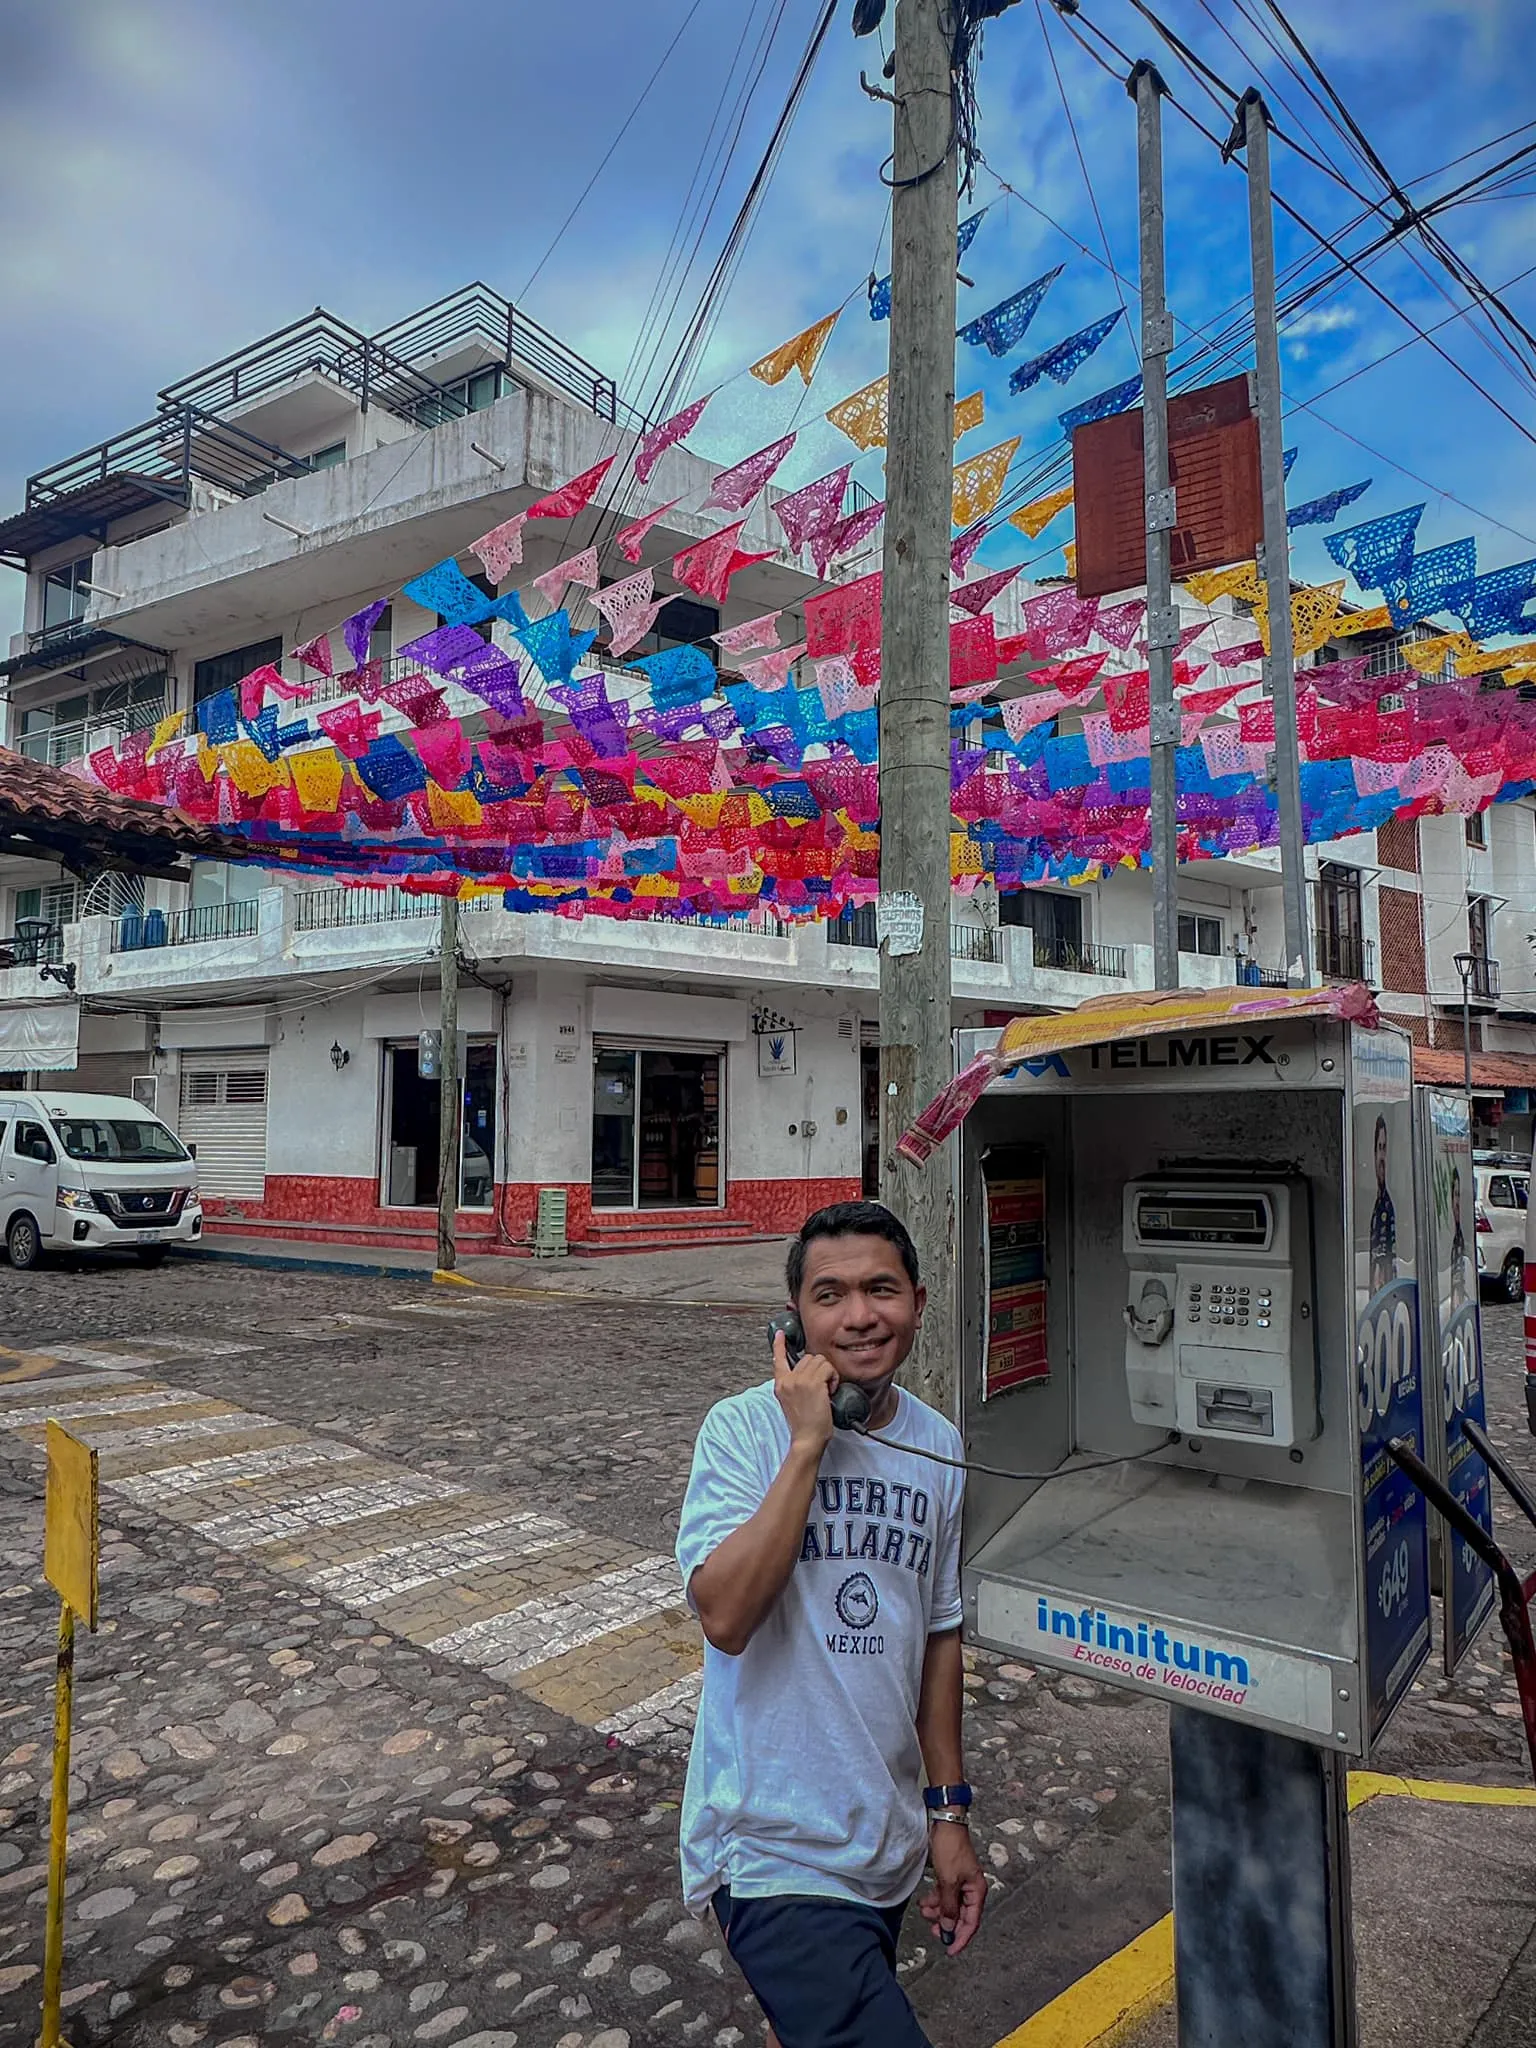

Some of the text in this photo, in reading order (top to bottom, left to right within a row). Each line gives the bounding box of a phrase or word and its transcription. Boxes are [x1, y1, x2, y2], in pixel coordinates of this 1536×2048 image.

[1089, 1035, 1276, 1069] TELMEX
[1357, 1301, 1412, 1433] 300
[816, 1476, 929, 1528] UERTO
[799, 1520, 933, 1579] ALLARTA
[1378, 1539, 1409, 1618] $649
[826, 1632, 885, 1655] MÉXICO
[1037, 1597, 1250, 1687] infinitum
[1073, 1644, 1248, 1705] Exceso de Velocidad
